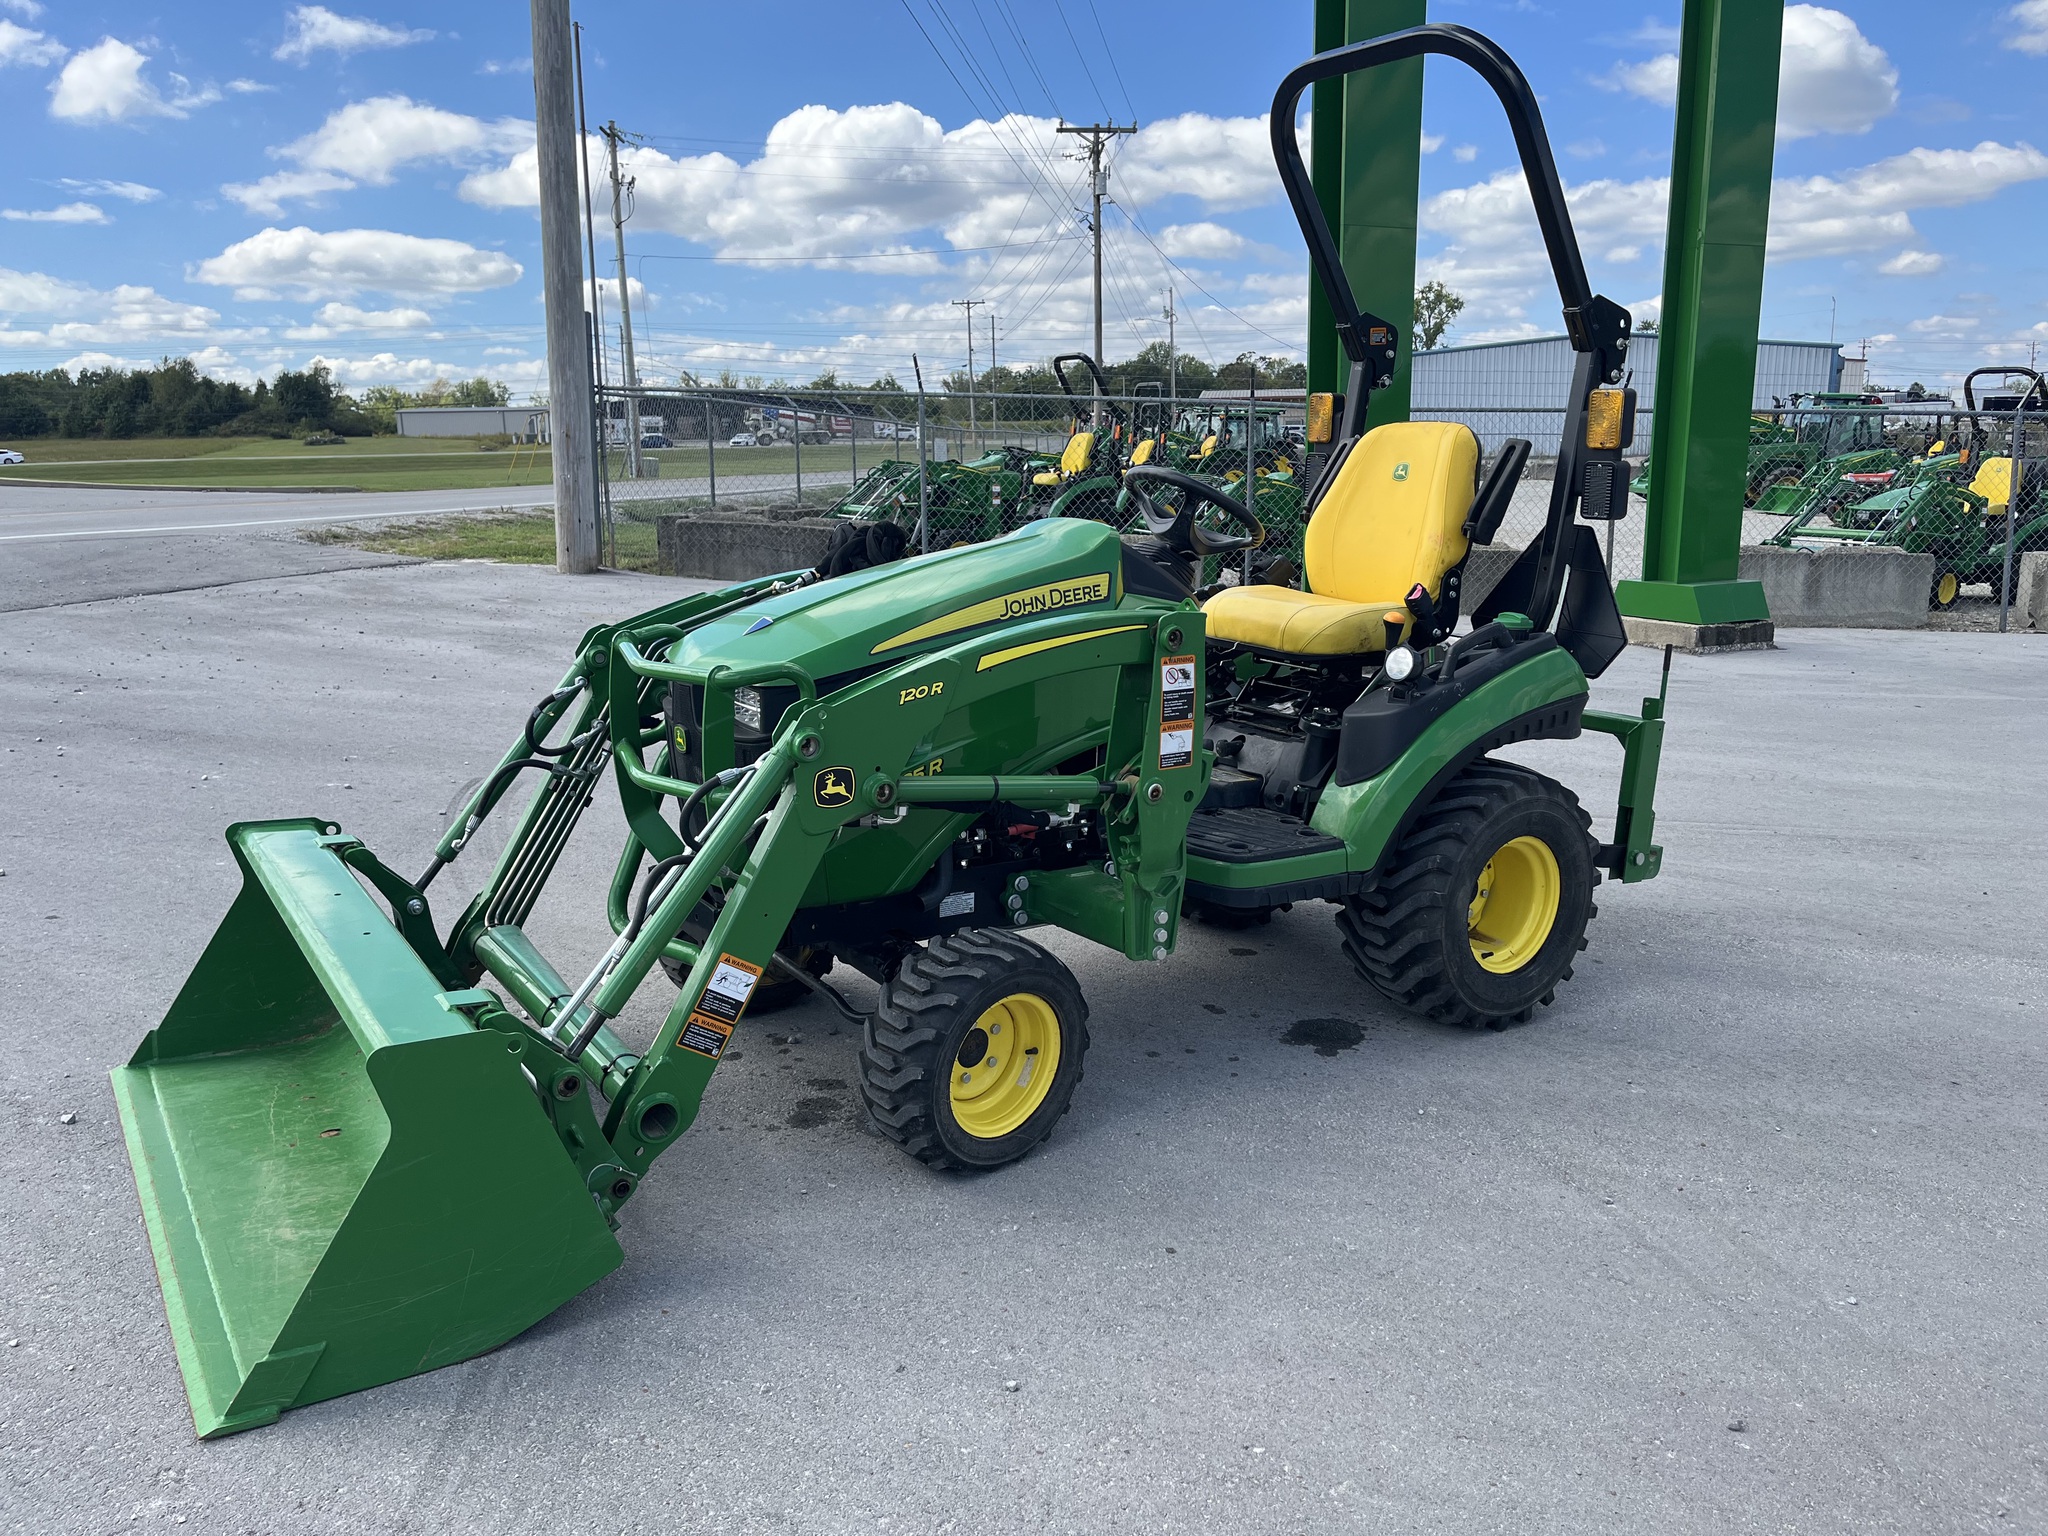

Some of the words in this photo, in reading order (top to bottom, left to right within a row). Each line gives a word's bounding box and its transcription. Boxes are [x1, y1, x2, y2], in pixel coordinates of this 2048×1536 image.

[1000, 594, 1046, 618] JOHN
[1049, 584, 1102, 606] DEERE
[1168, 656, 1194, 664] WARNING
[1167, 722, 1193, 731] WARNING
[731, 959, 757, 974] WARNING
[701, 1018, 728, 1033] WARNING
